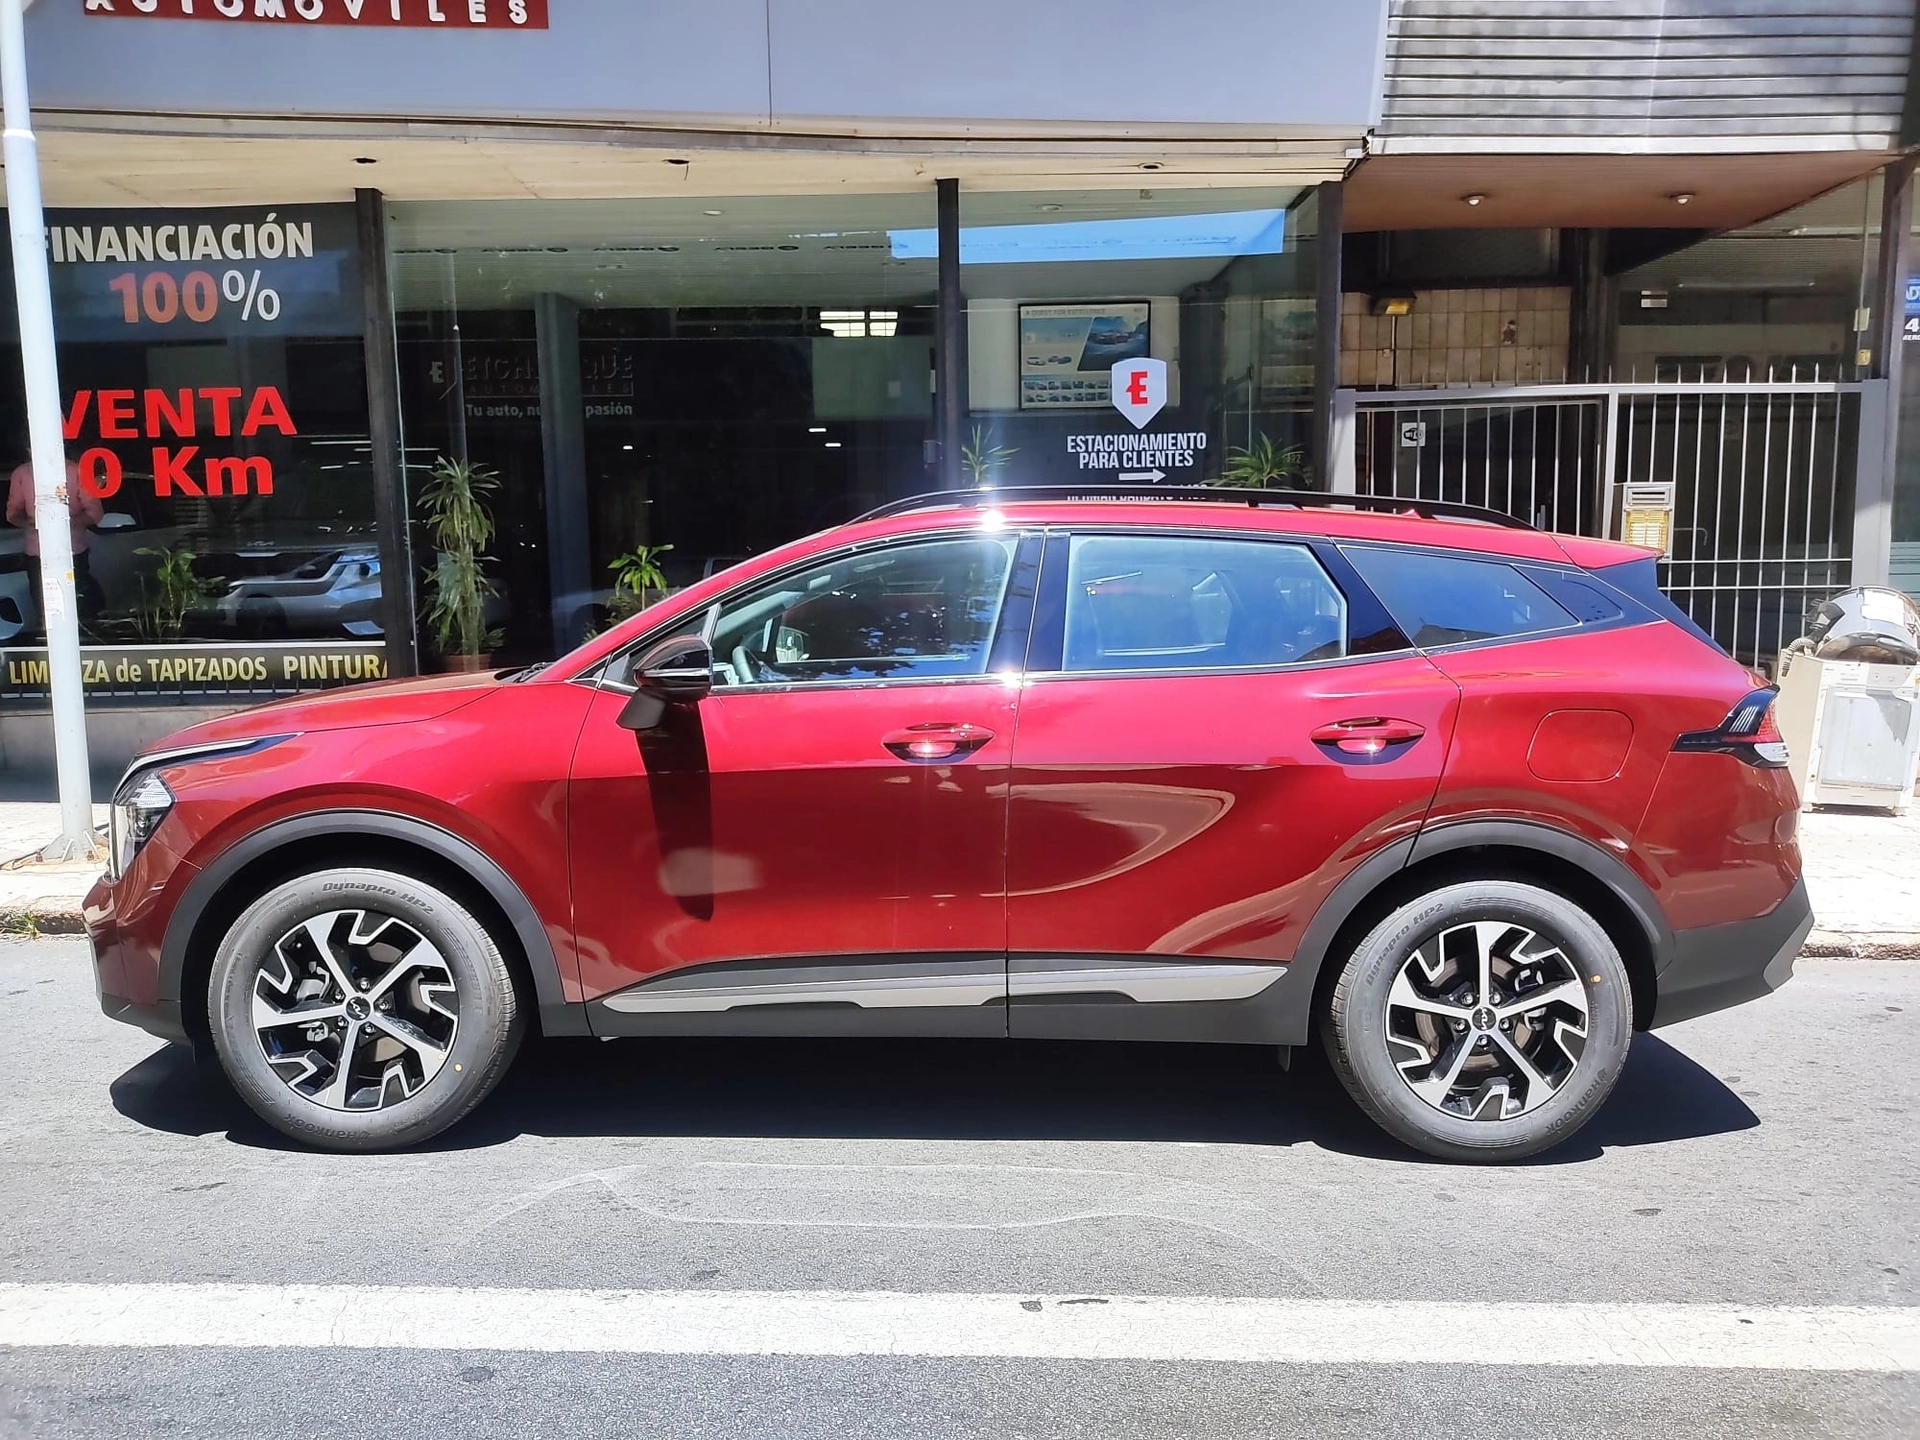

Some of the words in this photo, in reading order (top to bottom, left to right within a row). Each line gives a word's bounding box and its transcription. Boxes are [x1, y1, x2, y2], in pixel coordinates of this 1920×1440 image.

[44, 213, 314, 263] INANCIACIÓN
[109, 269, 281, 324] 100%
[61, 386, 298, 440] VENTA
[486, 403, 523, 418] auto,
[585, 401, 633, 419] pasión
[1067, 432, 1207, 453] ESTACIONAMIENTO
[1079, 451, 1119, 469] PARA
[1123, 449, 1194, 468] CLIENTES
[78, 447, 122, 499] 0
[152, 446, 274, 497] Km
[115, 658, 142, 683] de
[147, 656, 267, 682] TAPIZADOS
[322, 881, 397, 896] Dynapro
[400, 892, 435, 915] HP2
[1365, 924, 1410, 987] Dynapro
[1412, 902, 1445, 925] HP2
